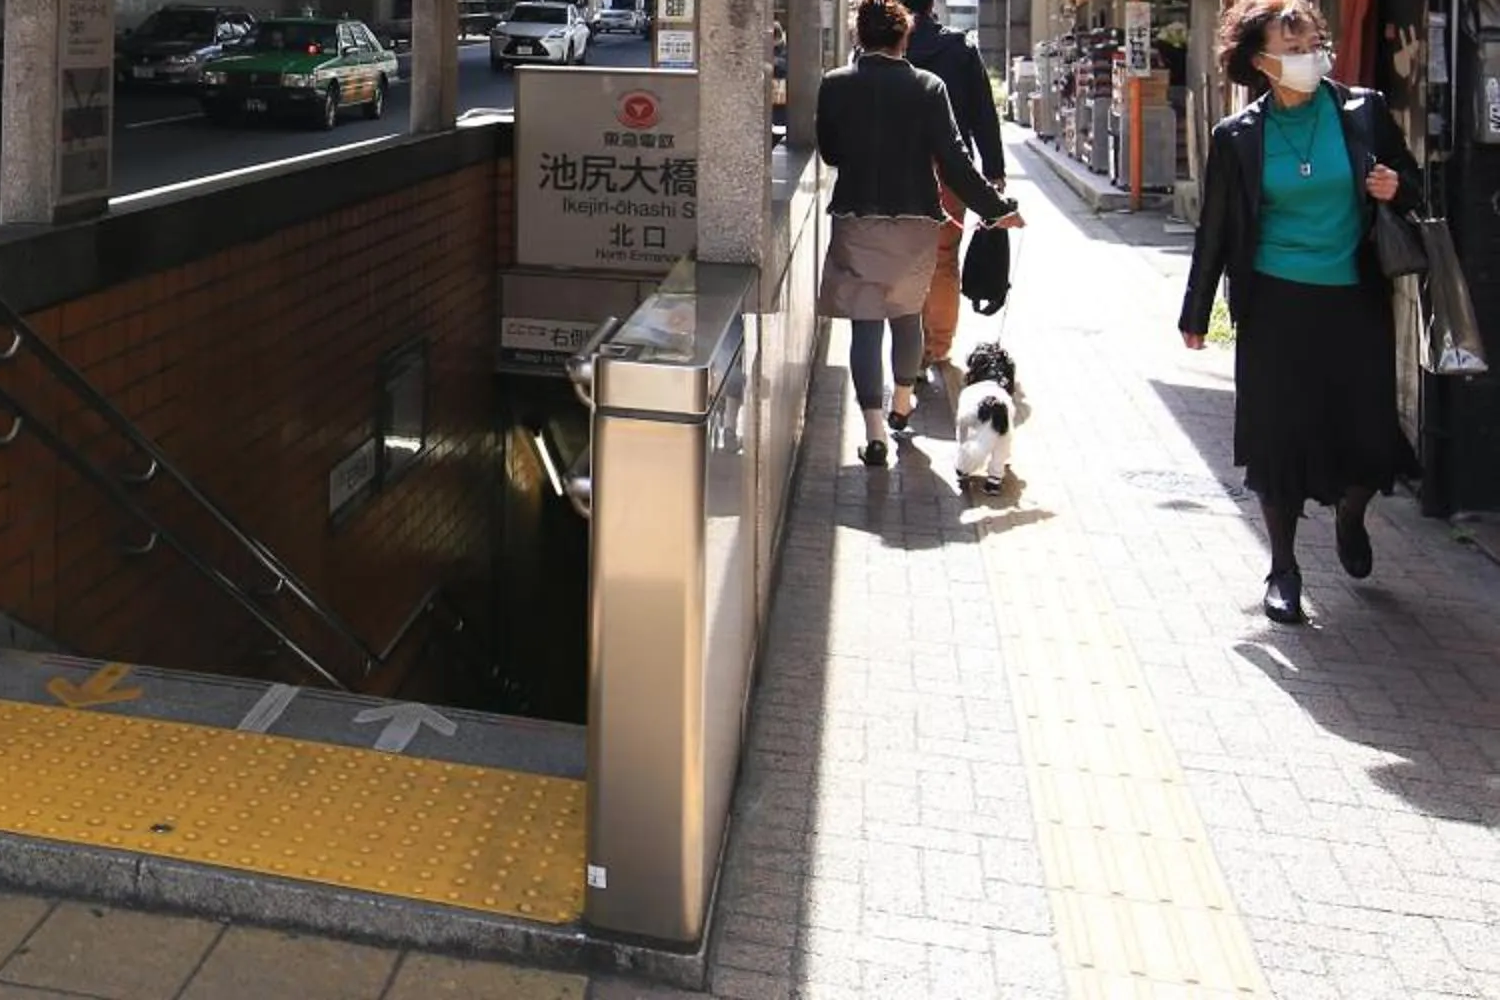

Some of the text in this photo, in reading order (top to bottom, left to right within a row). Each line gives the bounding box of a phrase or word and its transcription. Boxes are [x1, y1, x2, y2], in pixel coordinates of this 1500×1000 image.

[539, 152, 697, 198] 池尻大橋
[608, 222, 666, 249] 北口
